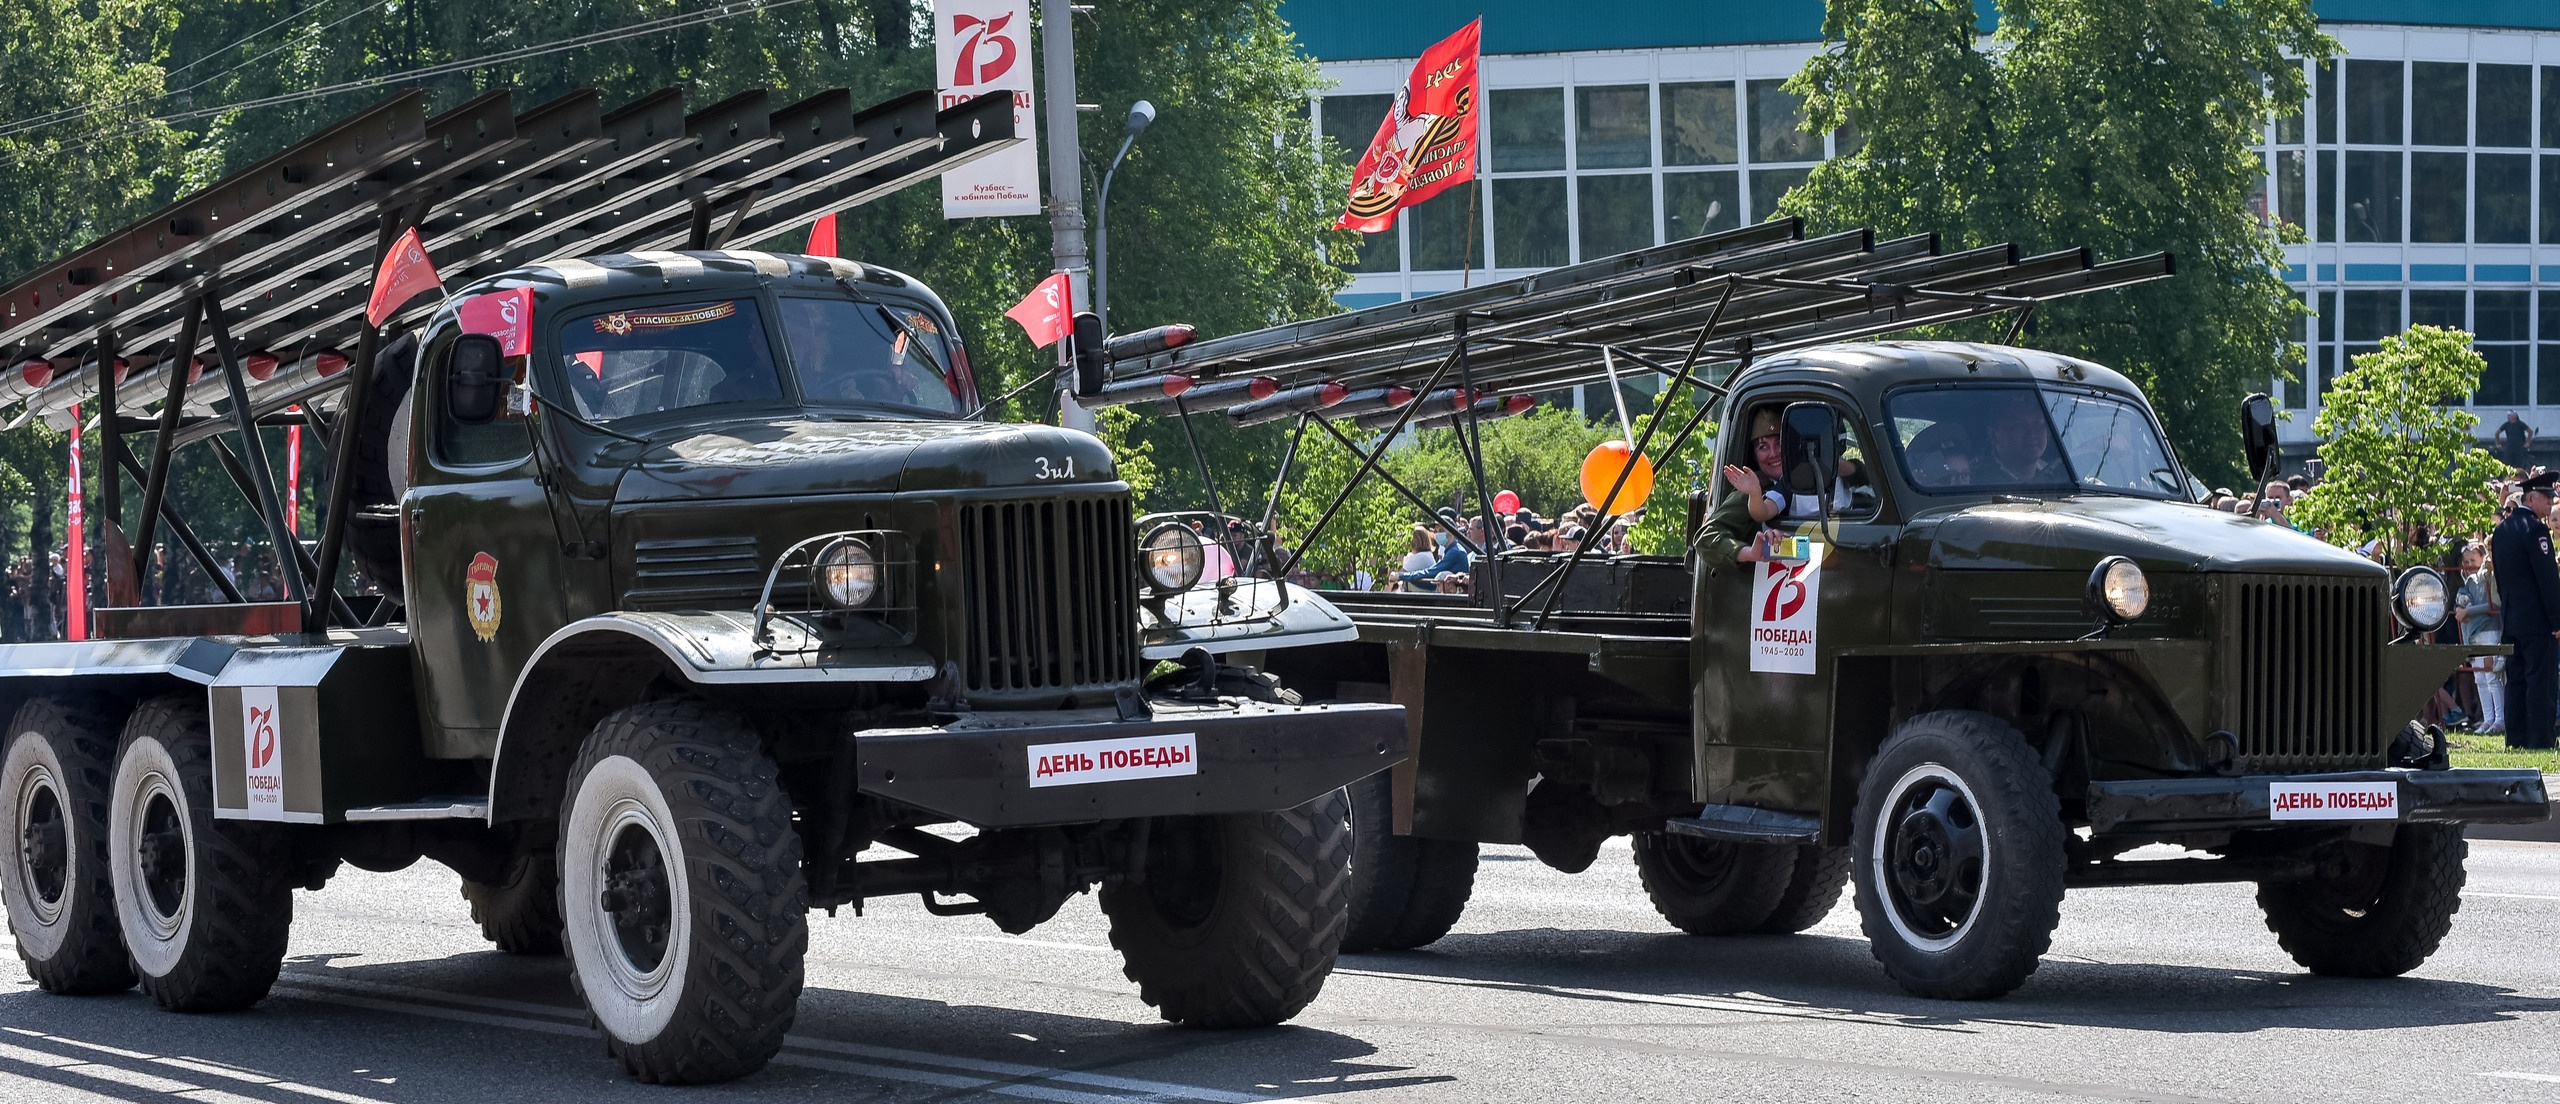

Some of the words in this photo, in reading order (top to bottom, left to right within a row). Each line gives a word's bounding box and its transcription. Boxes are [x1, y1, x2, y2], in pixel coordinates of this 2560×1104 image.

[953, 11, 1016, 86] 75
[962, 193, 995, 201] юбилею
[997, 192, 1029, 200] Победы
[974, 184, 1006, 193] Кузбасс
[633, 315, 677, 325] СПАСИБО
[1762, 560, 1808, 621] 75
[1754, 628, 1812, 646] ПОБЕДА!
[250, 704, 275, 768] 75
[1036, 753, 1094, 778] ДЕНЬ
[1099, 745, 1191, 769] ПОБЕДЫ
[248, 776, 281, 793] ПОБЕДА!
[2276, 792, 2324, 812] ДЕНЬ
[2328, 792, 2392, 811] ПОБЕДЫ
